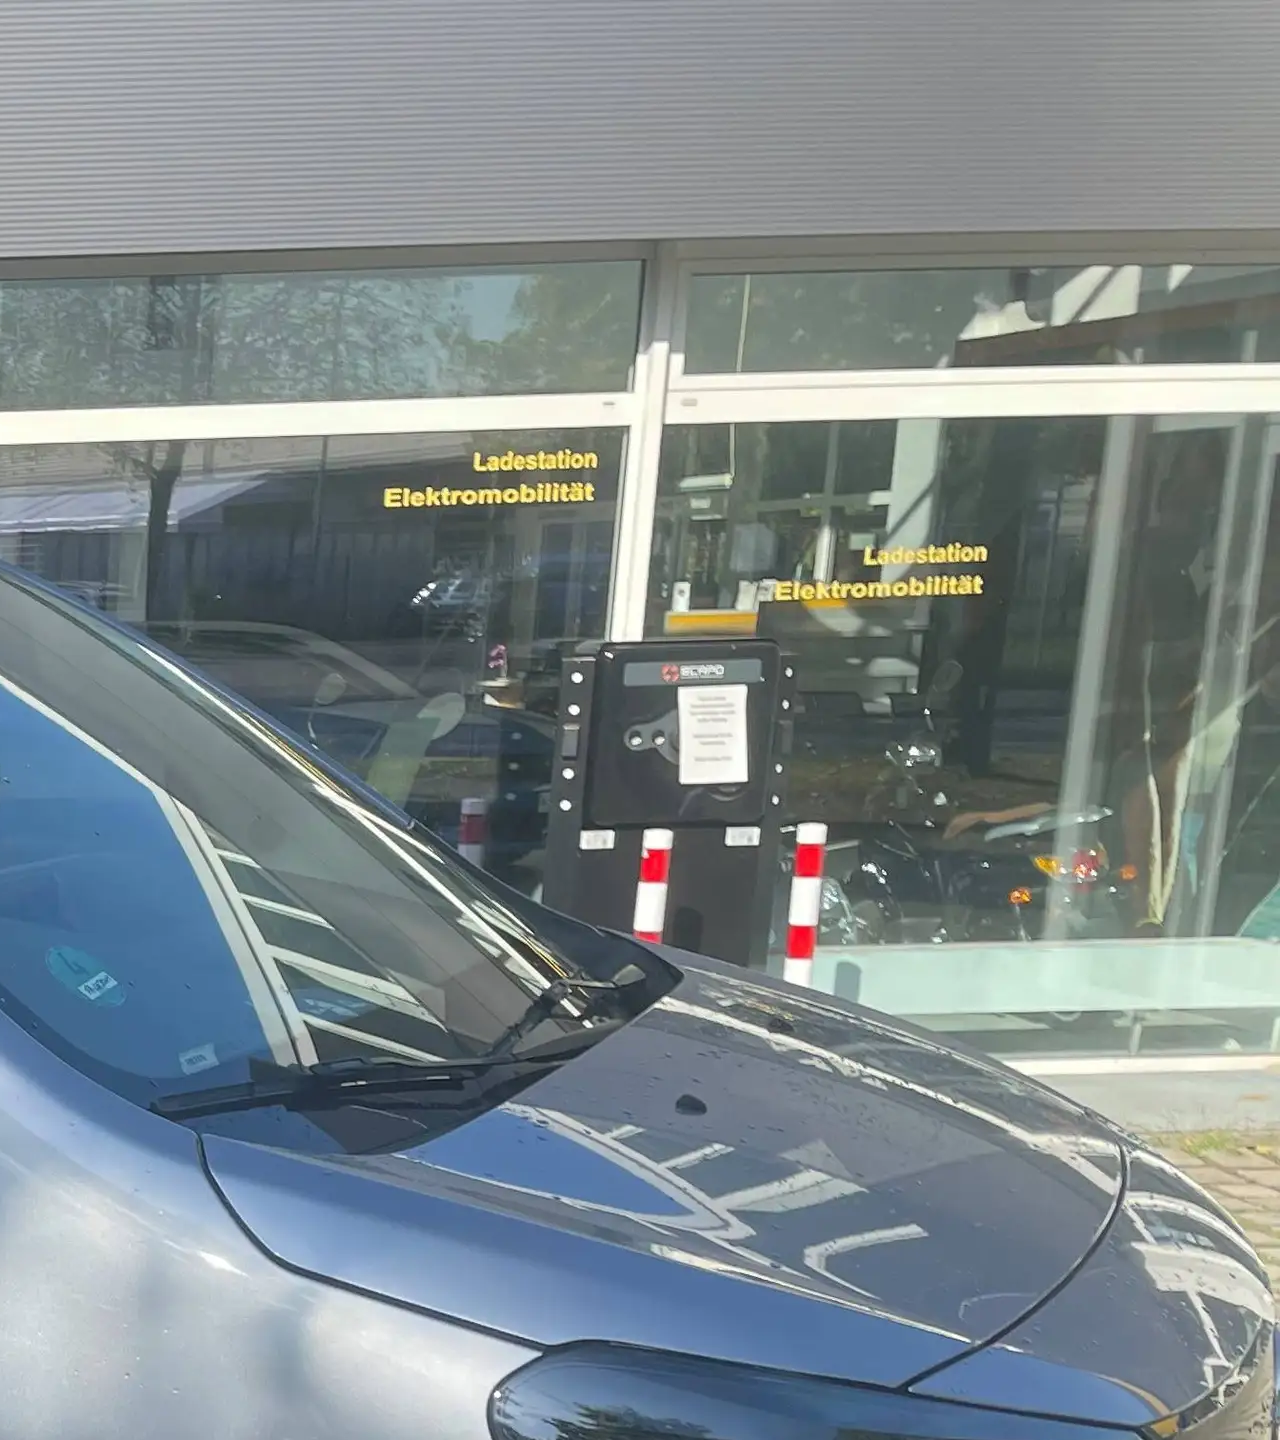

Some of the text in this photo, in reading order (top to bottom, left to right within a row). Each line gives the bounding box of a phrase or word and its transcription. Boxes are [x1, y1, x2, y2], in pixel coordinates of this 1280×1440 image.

[473, 449, 598, 471] Ladestation
[384, 482, 595, 508] Elektromobilität
[863, 542, 988, 566] Ladestation
[774, 574, 984, 601] Elektromobilität
